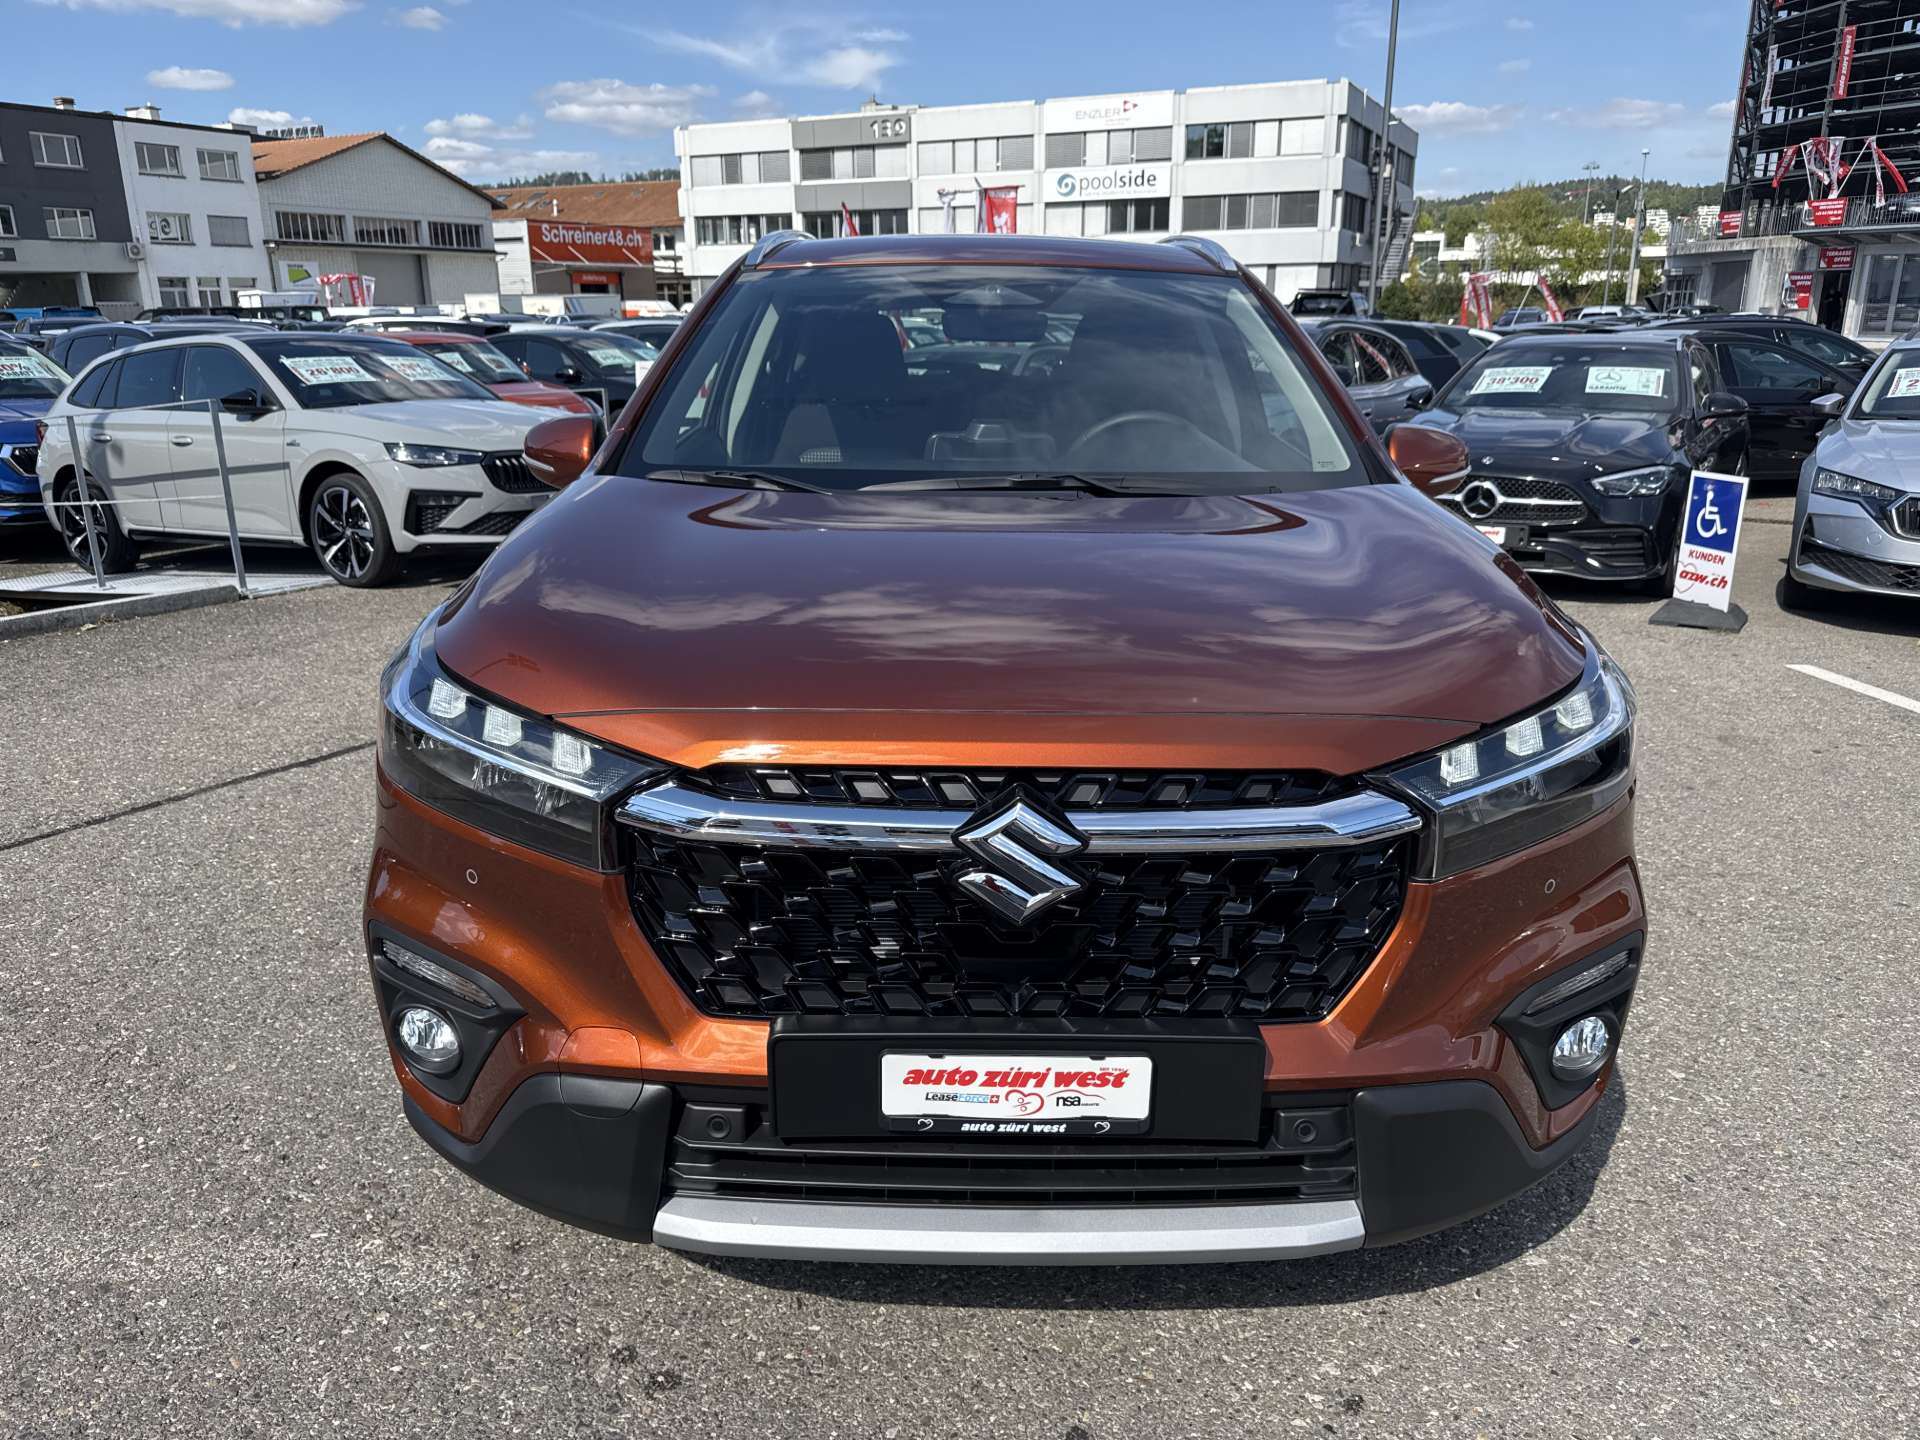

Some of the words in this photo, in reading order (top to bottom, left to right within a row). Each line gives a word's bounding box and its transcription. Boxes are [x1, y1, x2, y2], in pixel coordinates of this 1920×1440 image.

[1075, 107, 1121, 120] ENZLER
[1079, 169, 1157, 197] poolside
[541, 223, 642, 247] Schreiner48.ch
[1688, 549, 1726, 566] KUNDEN
[1679, 570, 1728, 589] azw.ch
[903, 1066, 978, 1086] auto
[978, 1066, 1052, 1088] züri
[1054, 1068, 1130, 1089] west
[1056, 1096, 1081, 1107] nsa
[961, 1122, 995, 1132] auto
[998, 1122, 1031, 1132] züri
[1032, 1123, 1067, 1133] west
